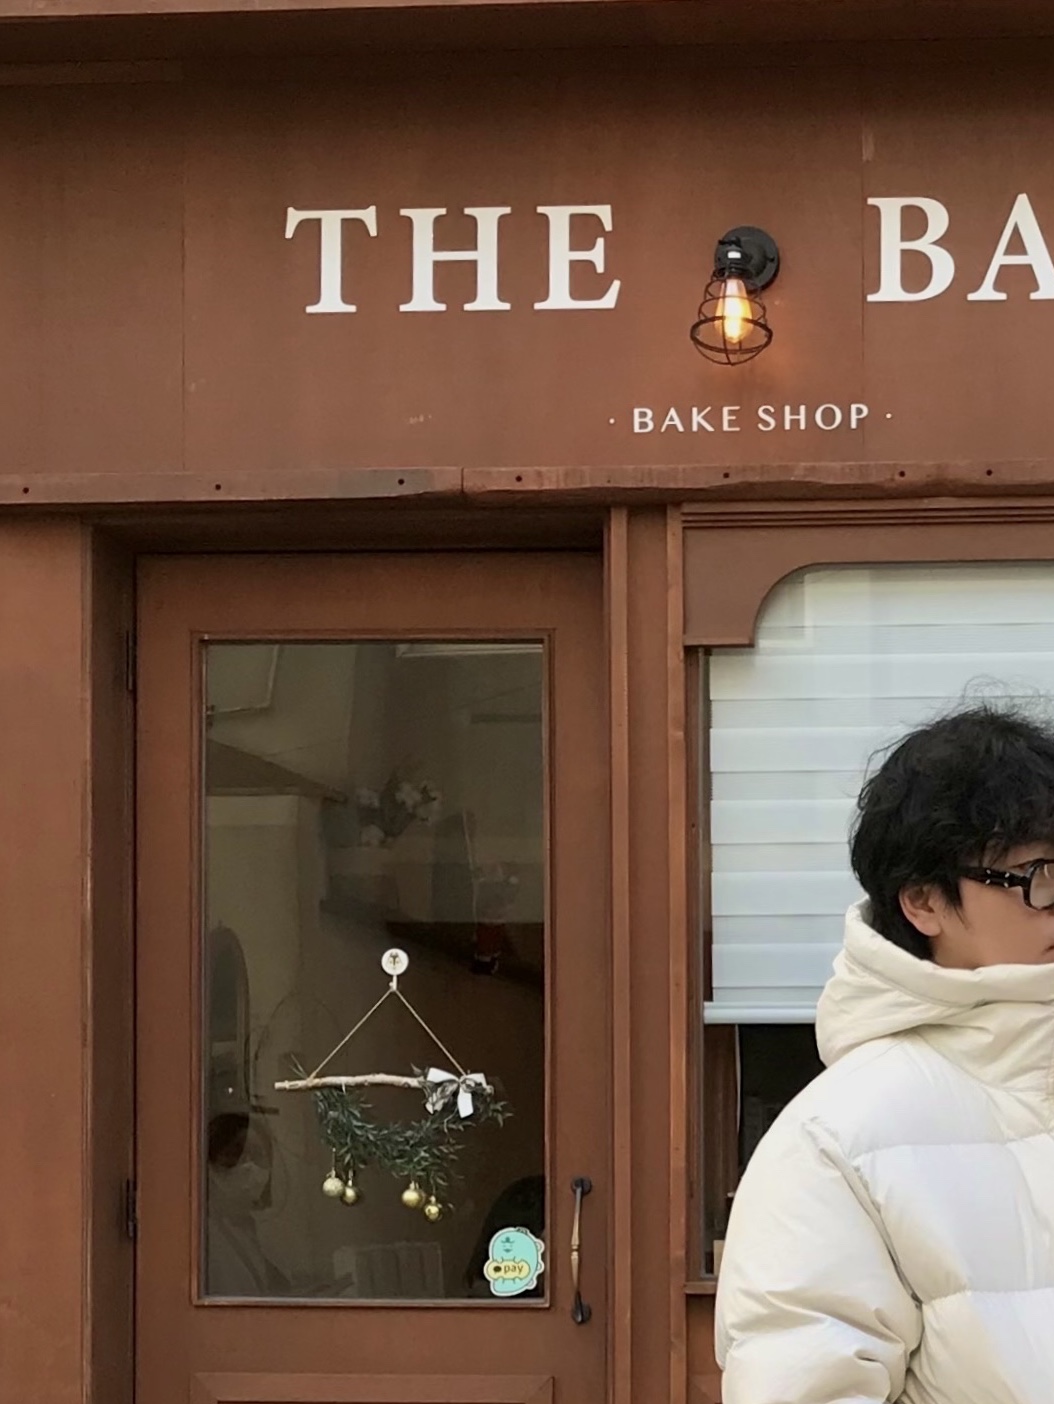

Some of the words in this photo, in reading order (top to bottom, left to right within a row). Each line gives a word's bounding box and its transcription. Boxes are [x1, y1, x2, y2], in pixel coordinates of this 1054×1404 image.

[284, 203, 622, 314] THE
[632, 405, 741, 434] BAKE
[756, 403, 870, 432] SHOP
[504, 1264, 524, 1275] pay
